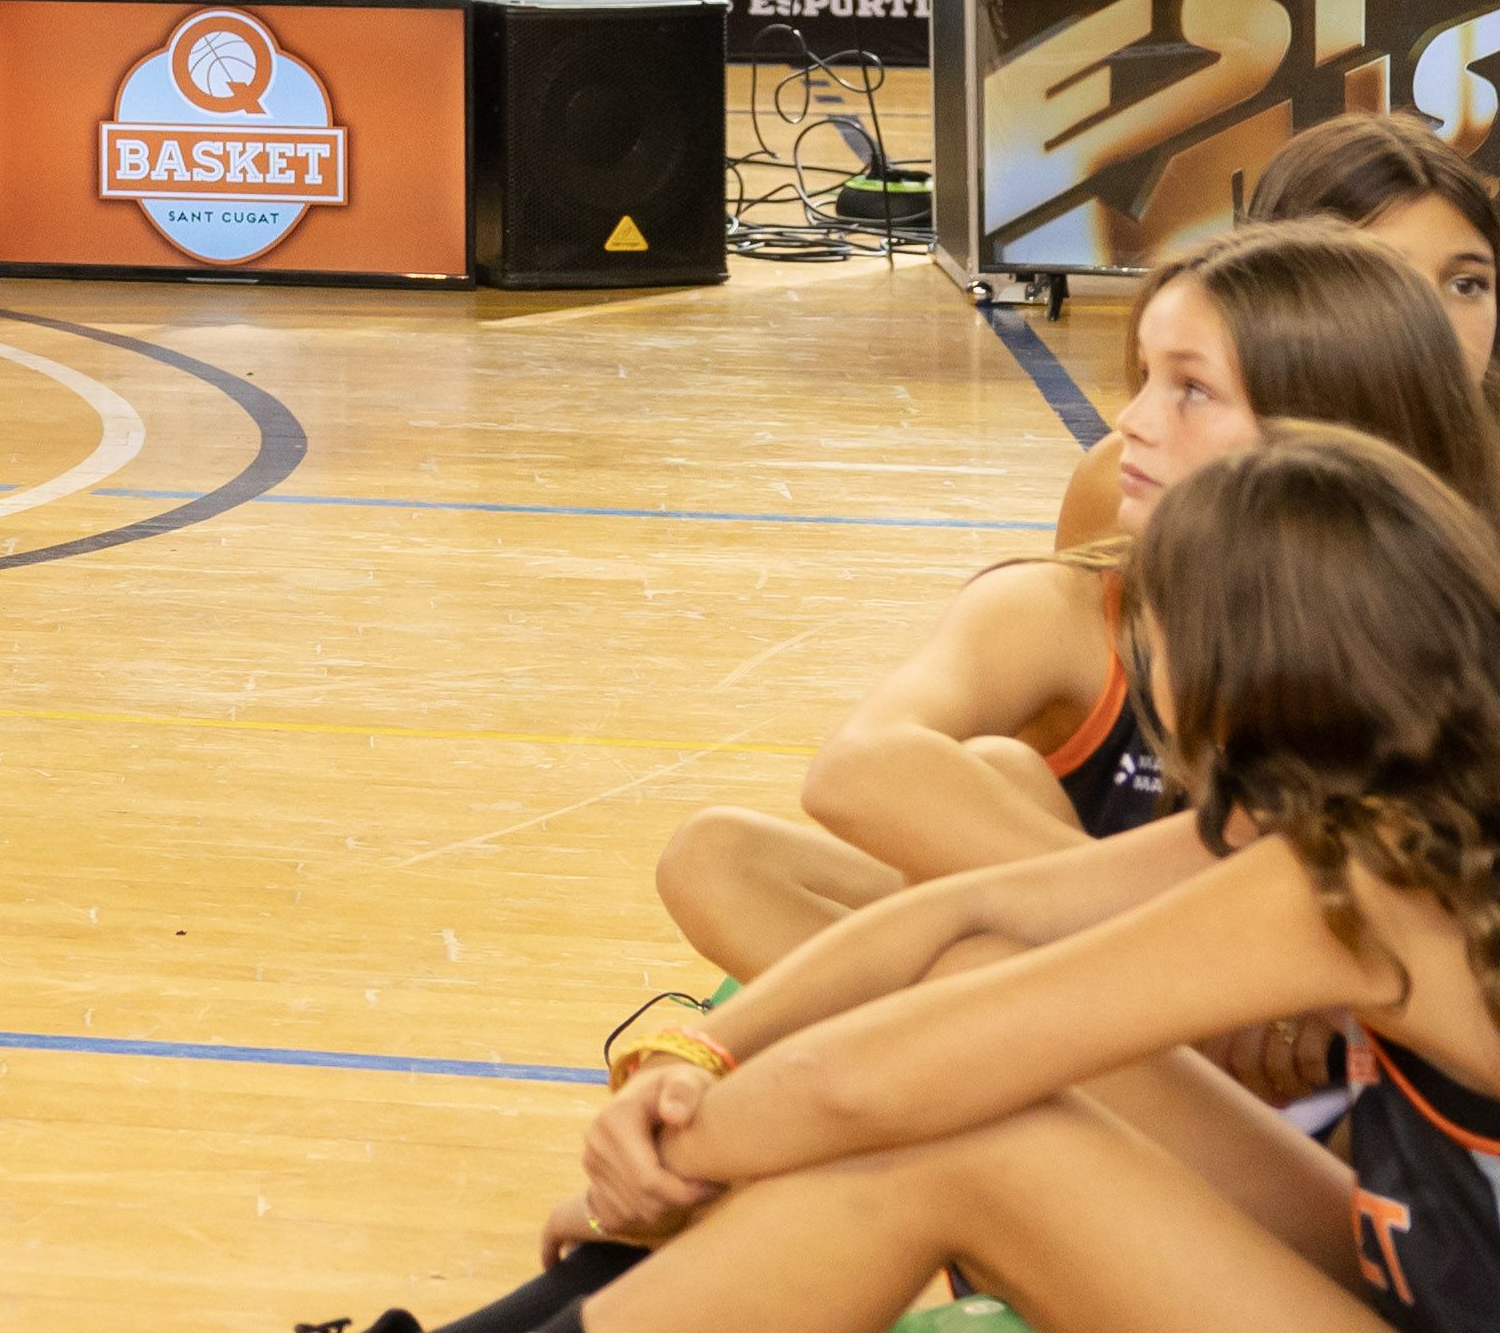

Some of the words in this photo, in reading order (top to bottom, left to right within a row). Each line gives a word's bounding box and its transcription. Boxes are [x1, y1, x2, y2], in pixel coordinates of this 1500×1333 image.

[171, 13, 274, 116] Q
[114, 138, 331, 186] BASKET
[167, 210, 213, 224] SANT
[221, 211, 281, 226] CUGAT
